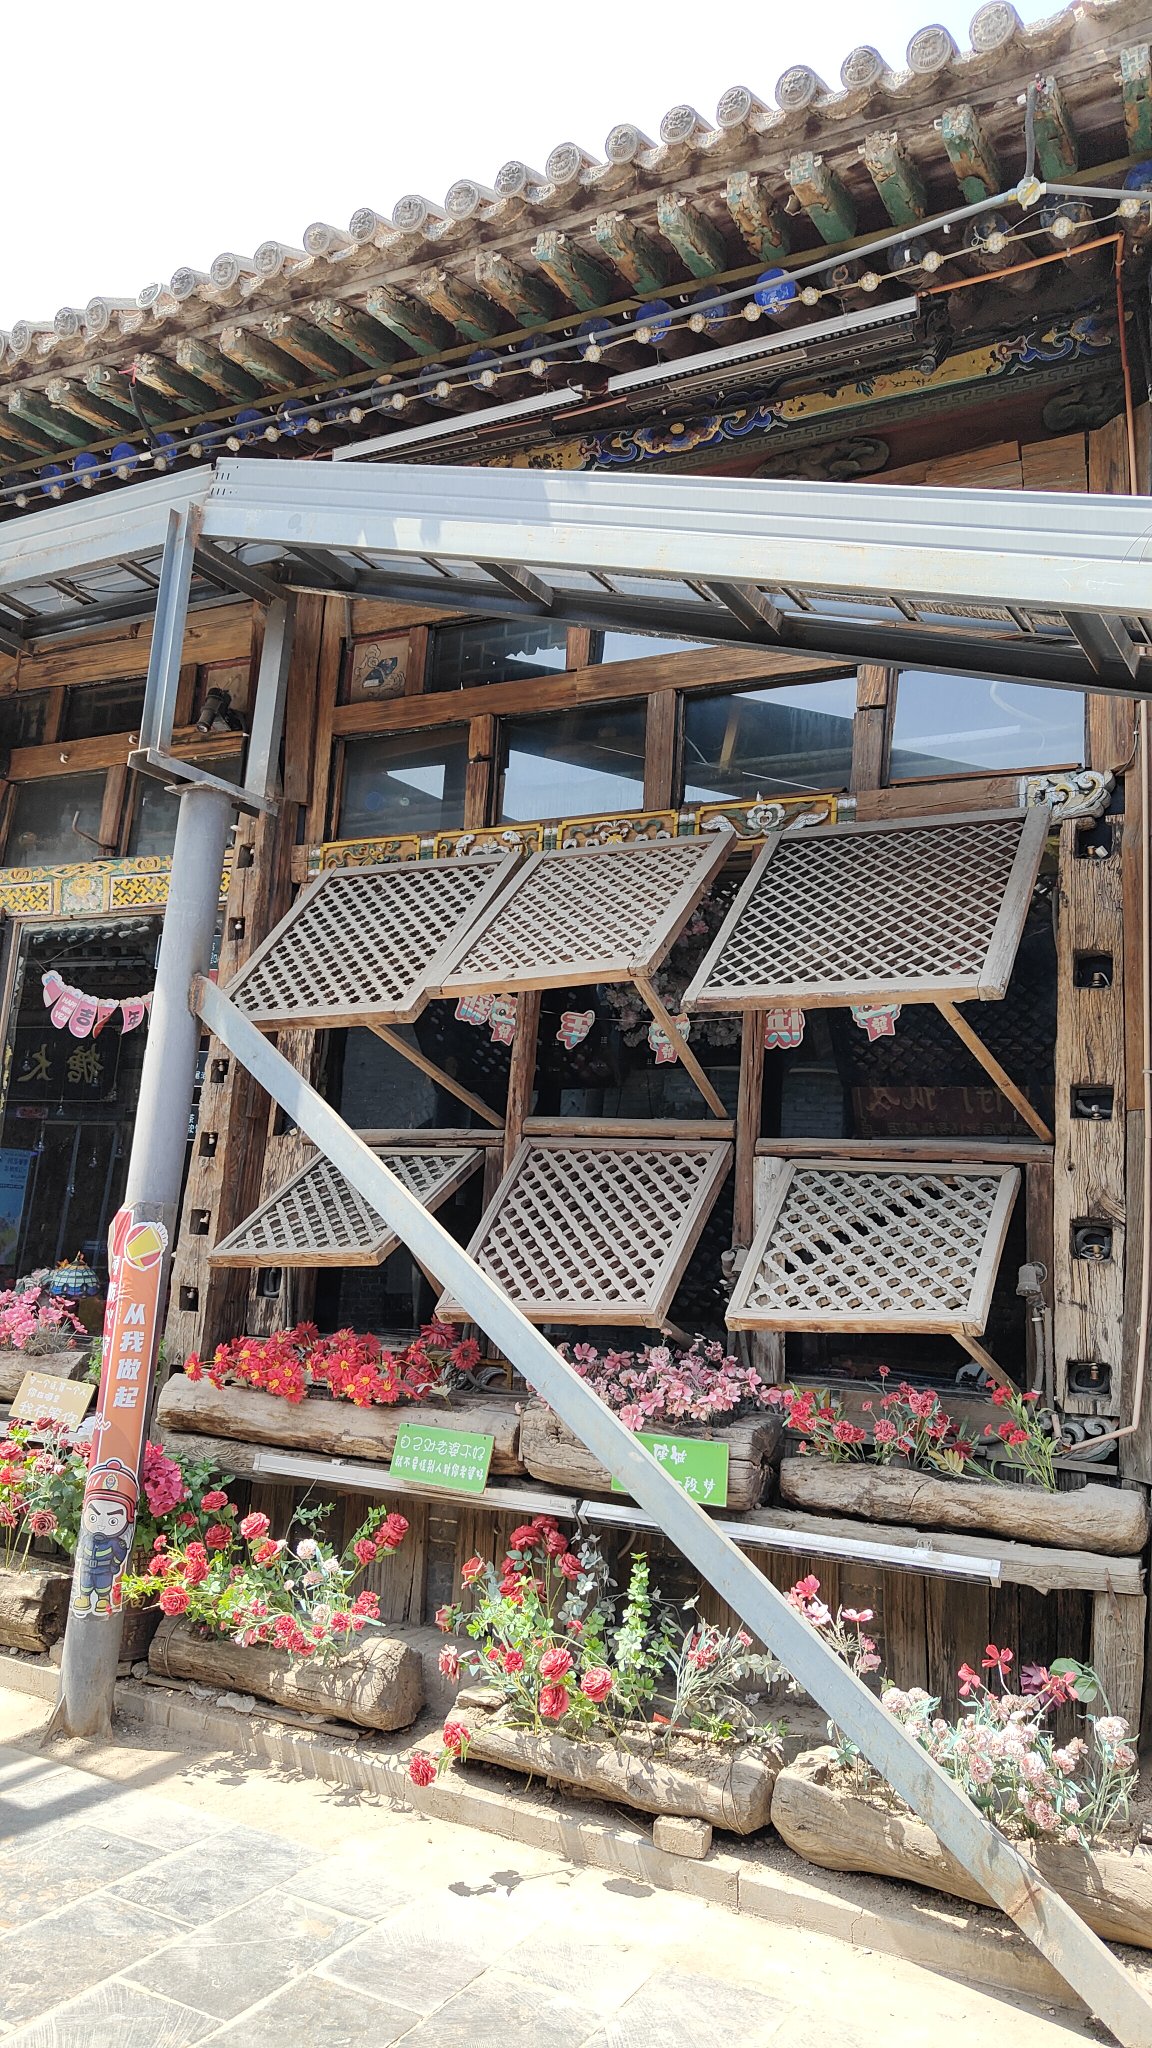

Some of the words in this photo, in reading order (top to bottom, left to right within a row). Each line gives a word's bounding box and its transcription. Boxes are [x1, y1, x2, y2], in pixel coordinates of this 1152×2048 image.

[113, 1303, 146, 1408] 从我做起
[400, 1434, 486, 1462] 自己对老婆不好
[675, 1476, 716, 1499] 段梦
